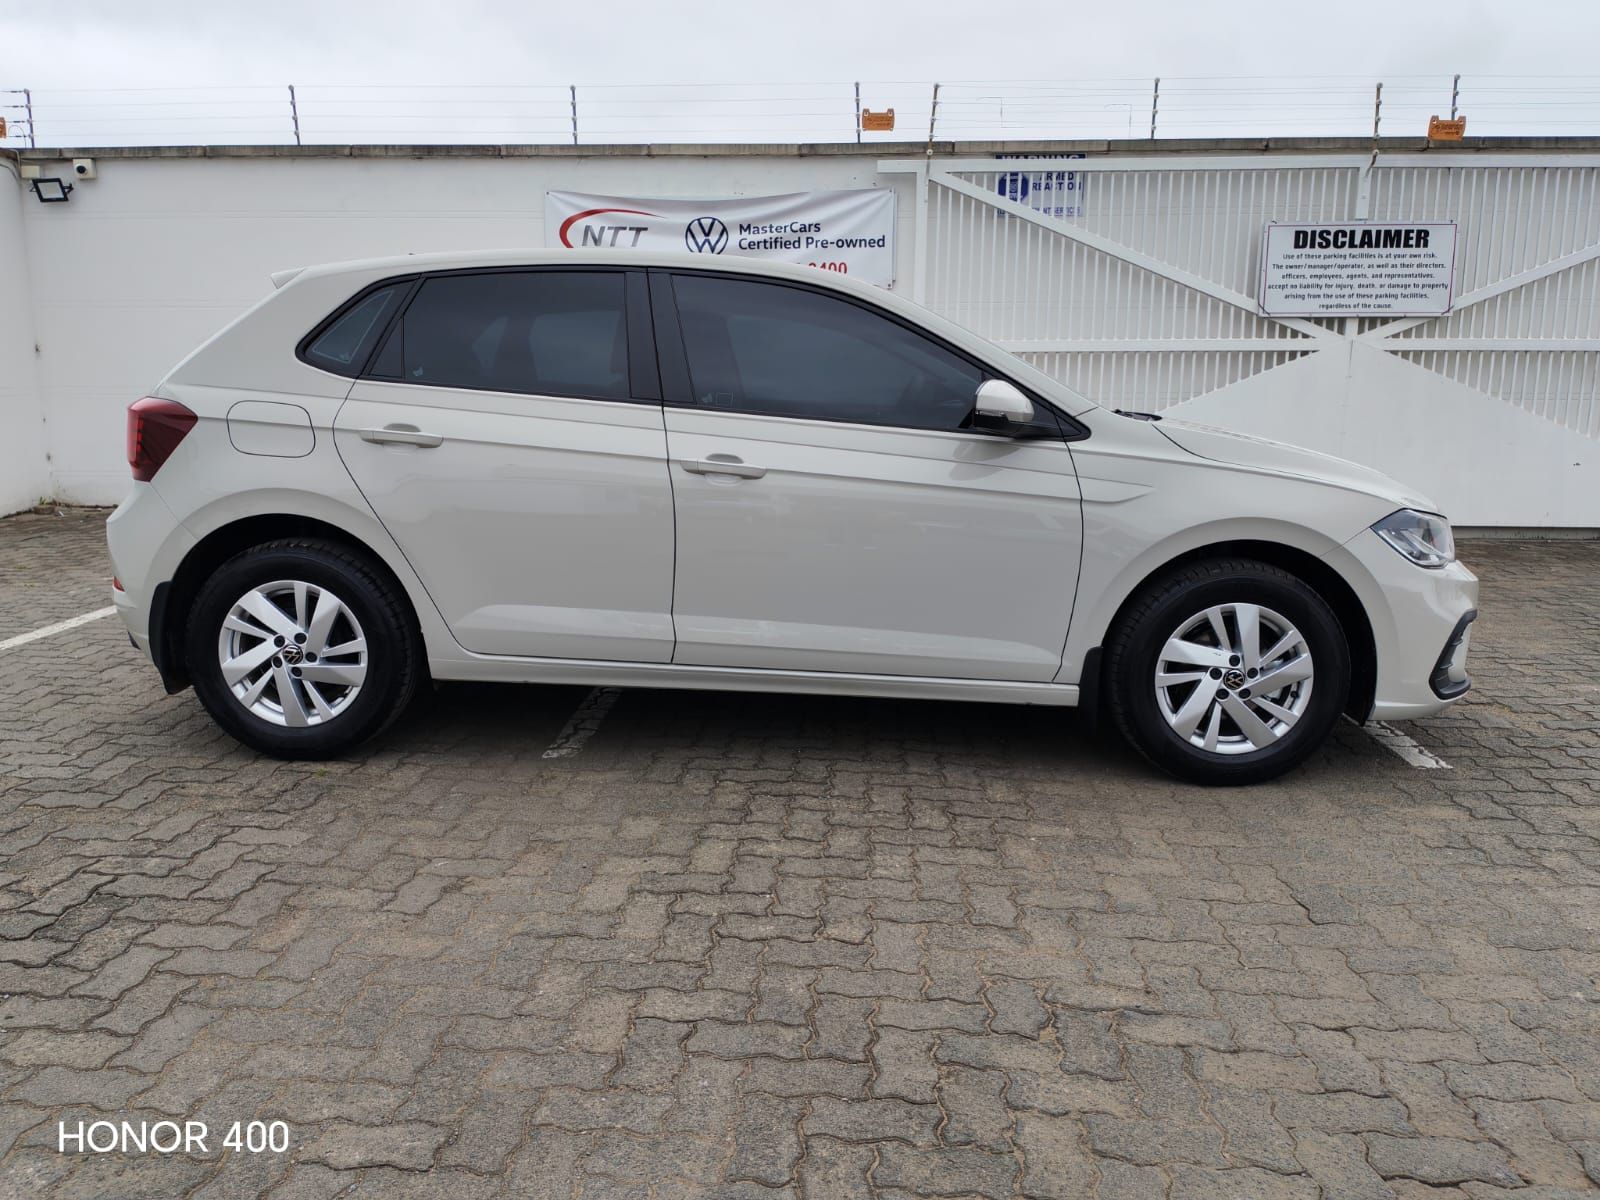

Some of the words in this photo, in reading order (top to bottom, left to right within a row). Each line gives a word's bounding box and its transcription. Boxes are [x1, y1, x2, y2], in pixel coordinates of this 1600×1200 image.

[582, 224, 648, 248] NTT
[739, 220, 821, 236] MasterCars
[738, 235, 801, 251] Certified
[805, 234, 886, 250] Pre-owned
[1293, 229, 1430, 249] DISCLAIMER
[1323, 252, 1347, 261] parking
[1348, 252, 1376, 260] facilities
[1268, 283, 1288, 291] accept
[1299, 282, 1323, 291] liability
[1387, 282, 1411, 290] damage
[1421, 282, 1449, 290] property
[1374, 292, 1399, 300] parking
